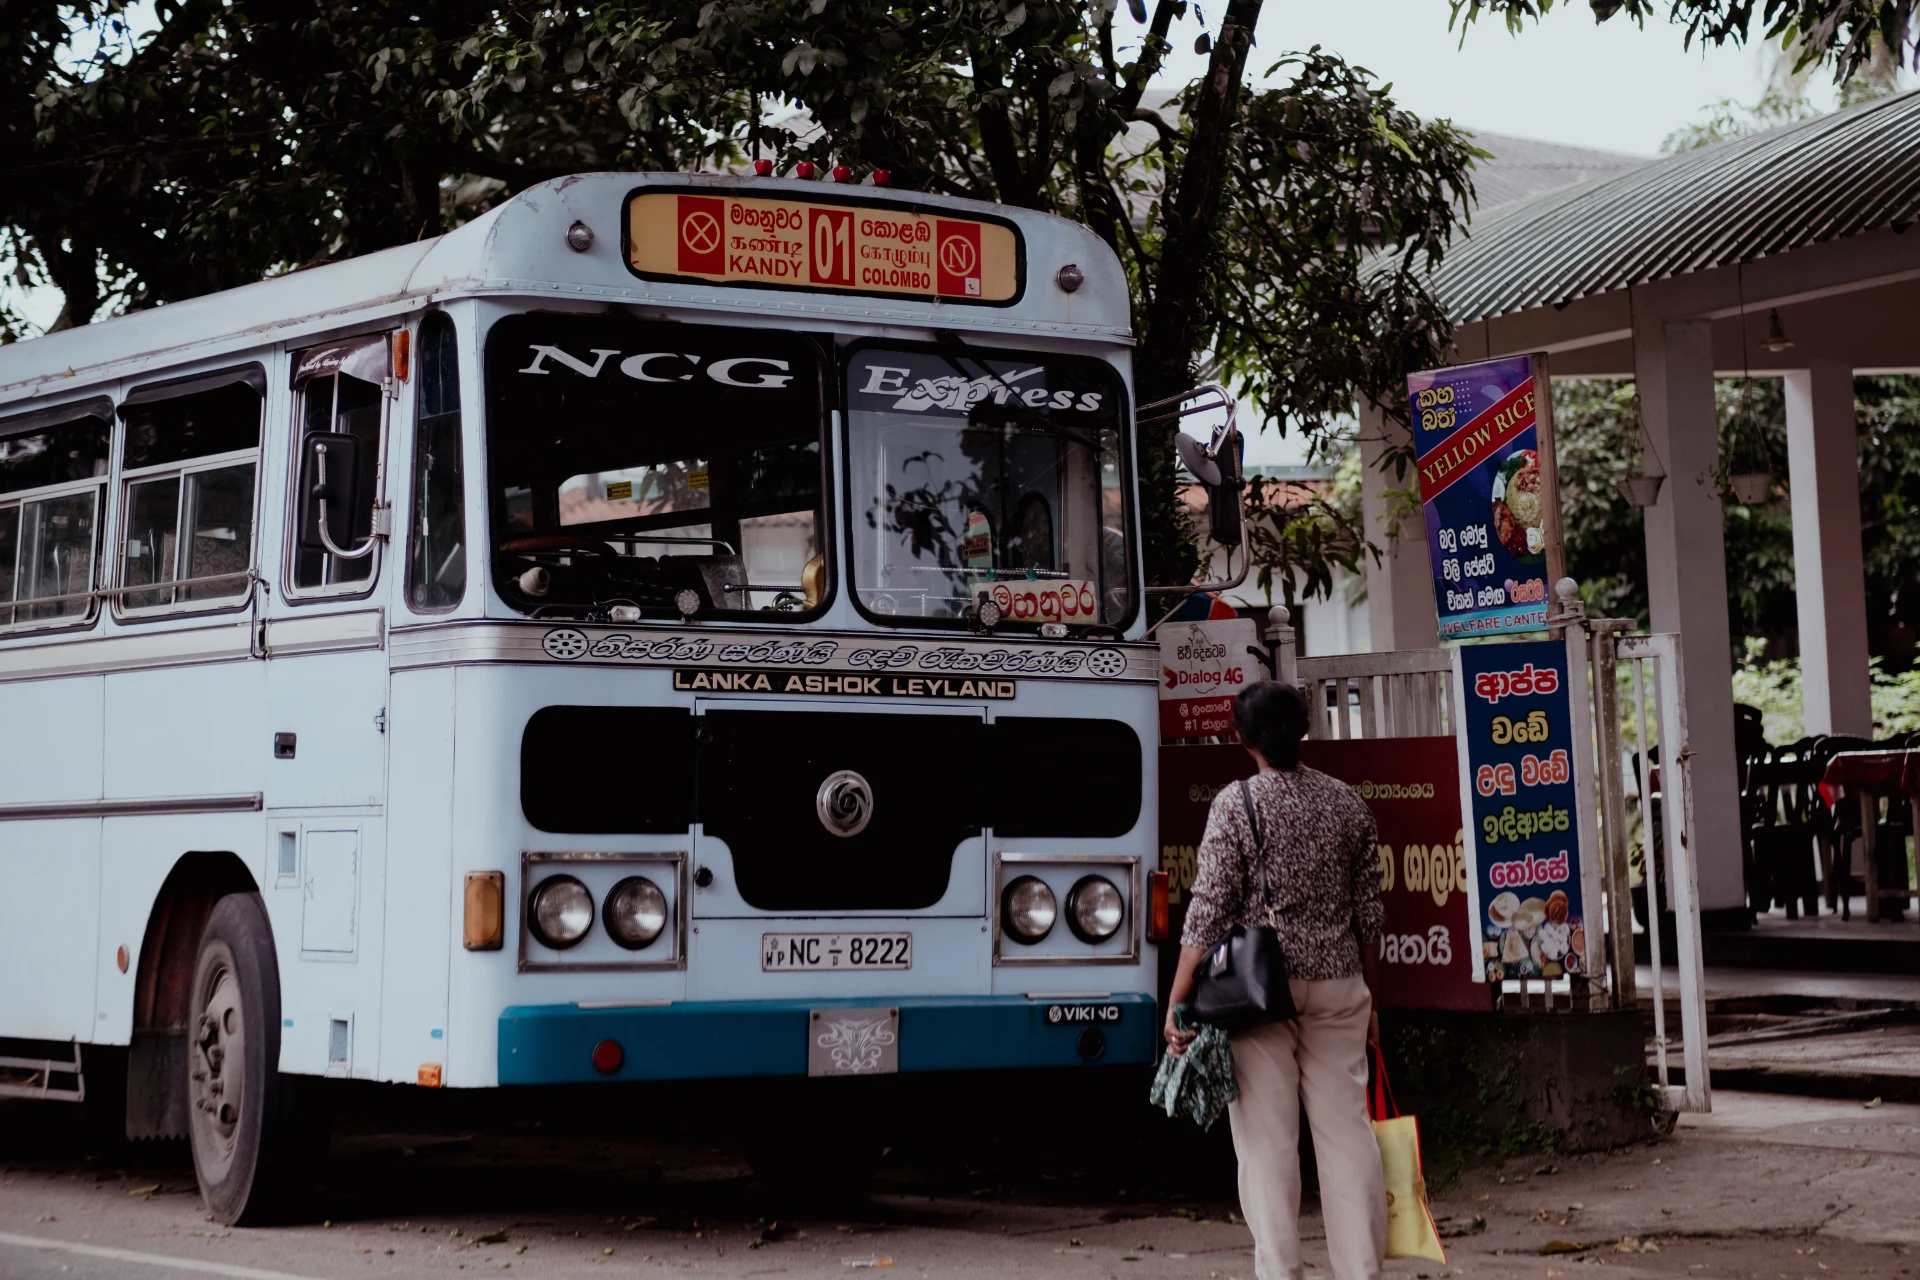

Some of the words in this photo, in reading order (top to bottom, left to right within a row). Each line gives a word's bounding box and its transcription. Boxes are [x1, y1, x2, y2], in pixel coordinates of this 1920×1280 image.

[730, 203, 803, 233] මහනුවර
[860, 219, 931, 244] කොළඹ
[730, 234, 803, 258] கண்டி
[814, 213, 850, 281] 01
[860, 244, 931, 269] கொழும்பு
[947, 242, 969, 270] N
[729, 254, 803, 278] KANDY
[862, 267, 931, 289] COLOMBO
[517, 343, 795, 389] NCG
[858, 364, 1103, 414] Express
[1418, 385, 1455, 408] කහ
[1421, 406, 1457, 432] බත්
[1422, 422, 1492, 485] YELLOW
[1493, 391, 1536, 435] RICE
[992, 581, 1095, 622] මහනුවර
[1443, 616, 1501, 635] WELFARE
[675, 670, 777, 691] LANKA
[785, 675, 882, 695] ASHOK
[892, 678, 1015, 698] LEYLAND
[1179, 669, 1221, 685] Dialog
[1224, 667, 1244, 685] 4G
[1475, 662, 1559, 704] ආප්ප
[1184, 719, 1198, 731] #1
[1491, 709, 1549, 746] වඩේ
[1521, 749, 1569, 787] වඩේ
[1489, 849, 1570, 889] තෝසේ
[790, 938, 820, 966] NC
[849, 937, 909, 965] 8222
[1064, 1005, 1119, 1021] VIKING
